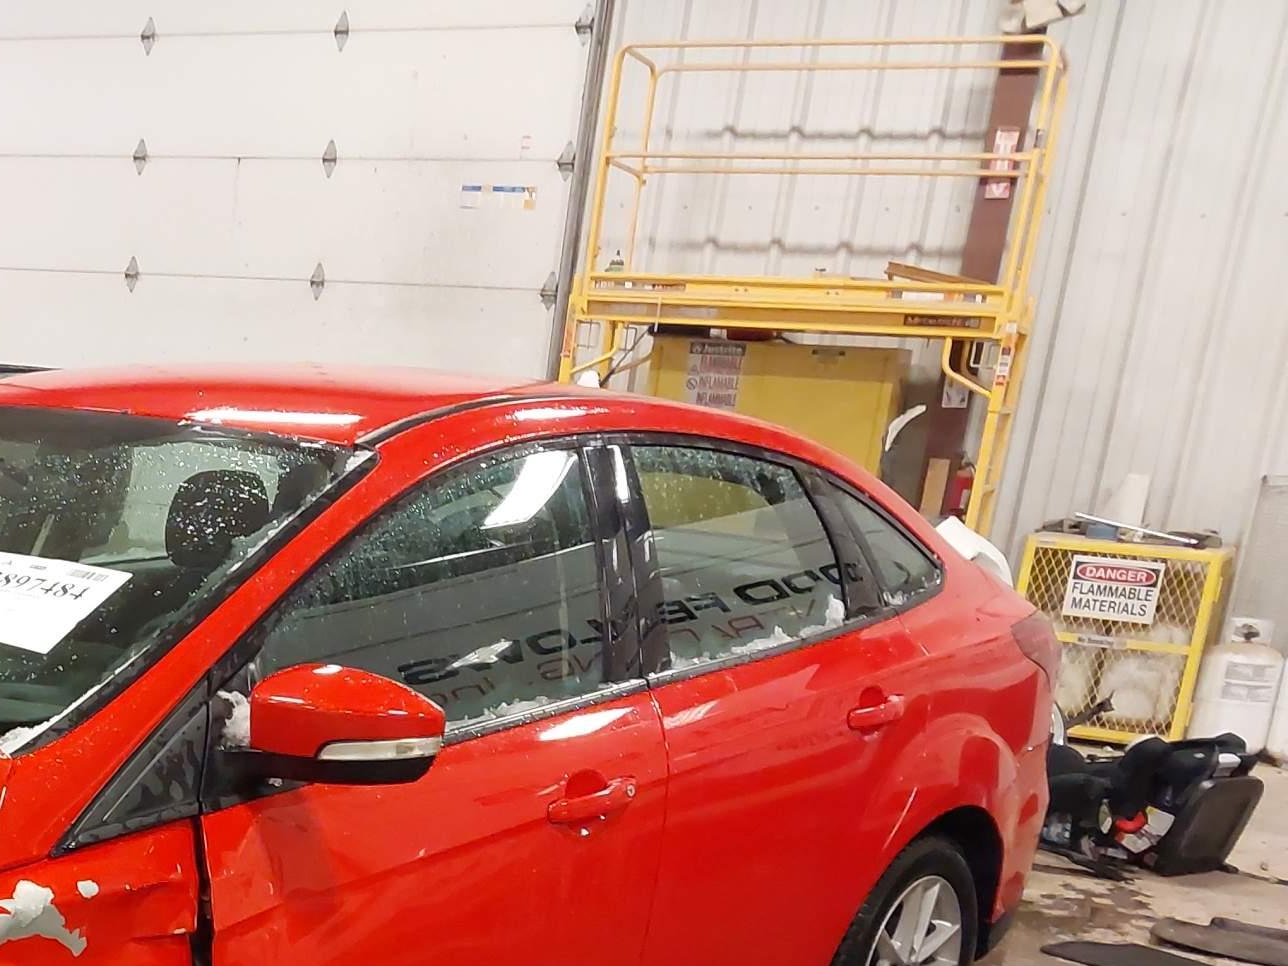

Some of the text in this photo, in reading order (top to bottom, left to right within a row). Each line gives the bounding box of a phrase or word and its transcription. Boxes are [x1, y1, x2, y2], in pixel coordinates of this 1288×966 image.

[1085, 566, 1148, 582] DANGER
[1072, 582, 1154, 601] FLAMMABLE
[1071, 597, 1148, 617] MATERIALS
